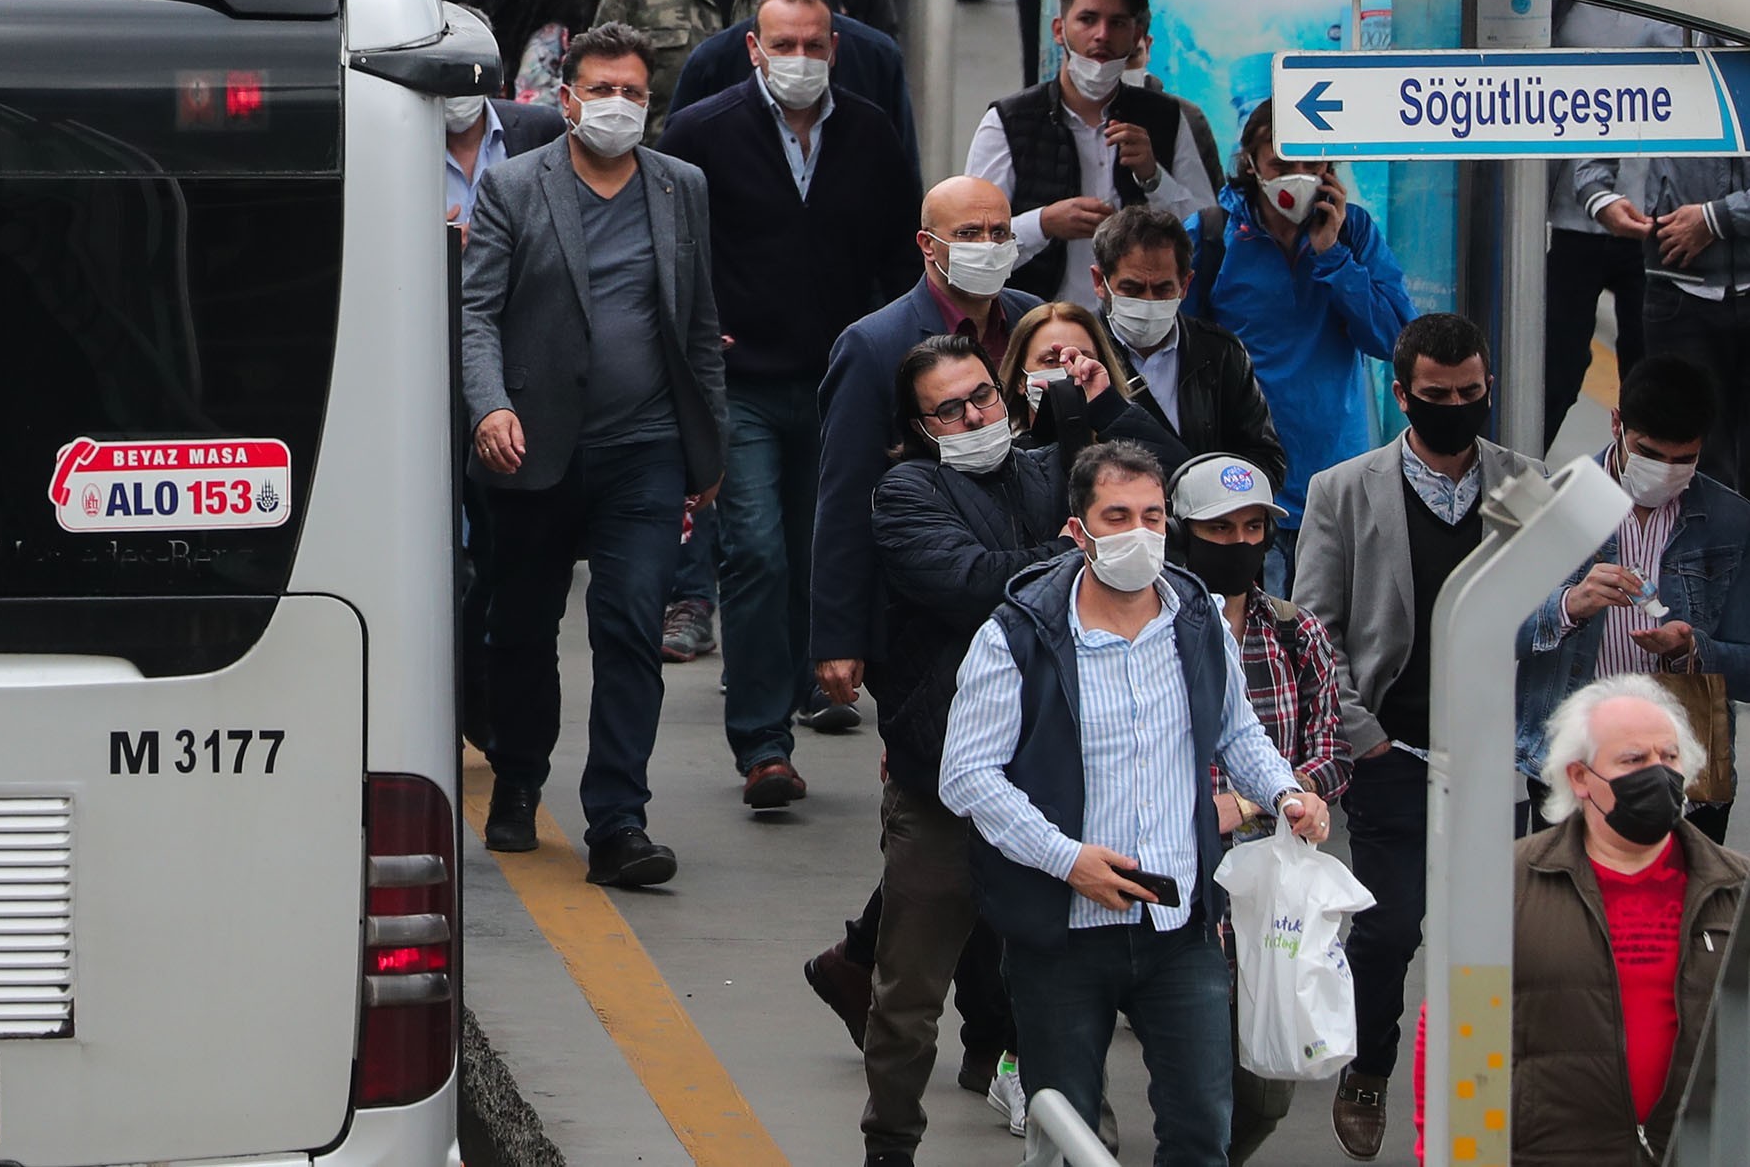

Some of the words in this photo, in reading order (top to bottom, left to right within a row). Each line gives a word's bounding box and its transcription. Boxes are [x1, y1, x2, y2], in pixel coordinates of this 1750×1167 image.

[1400, 77, 1672, 138] Söğütlüçeşme
[113, 448, 179, 467] BEYAZ
[188, 447, 249, 465] MASA
[106, 481, 179, 517] ALO
[186, 479, 252, 515] 153
[109, 731, 160, 775] M
[174, 729, 286, 775] 3177
